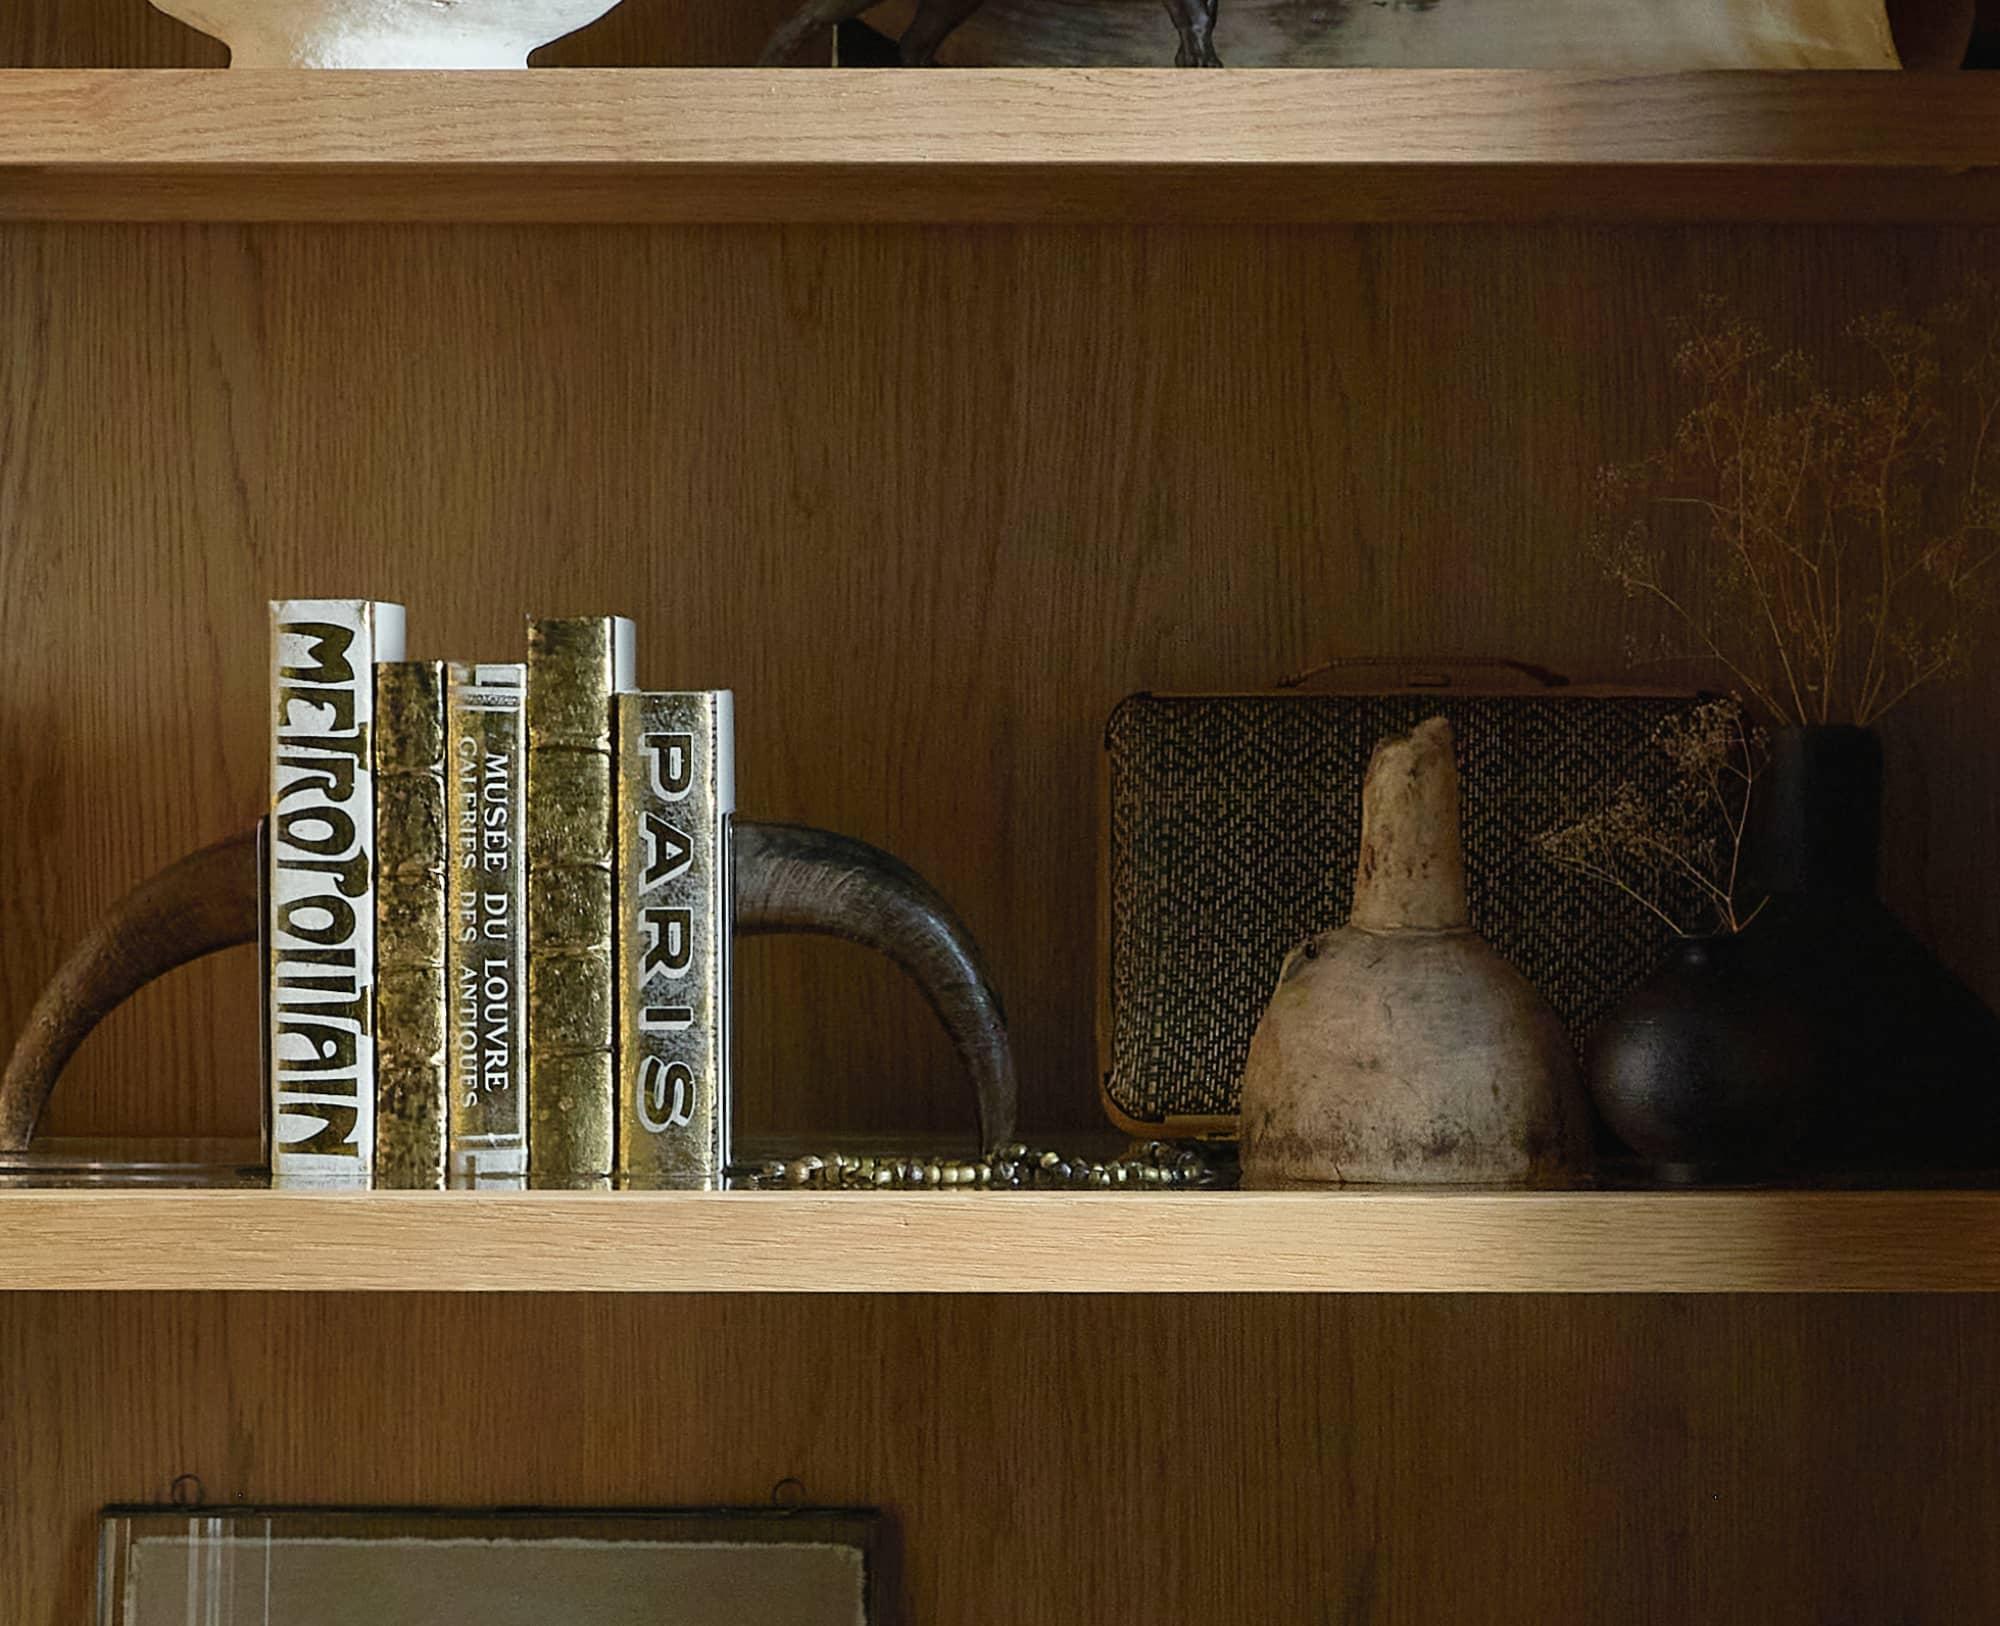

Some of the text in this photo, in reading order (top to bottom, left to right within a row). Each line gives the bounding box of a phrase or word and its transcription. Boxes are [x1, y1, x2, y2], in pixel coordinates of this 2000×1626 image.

[459, 736, 478, 1108] GALERIES DES ANTIQUES
[484, 752, 512, 1092] MUSÉE DU LOUVRE
[637, 732, 695, 1133] PARIS
